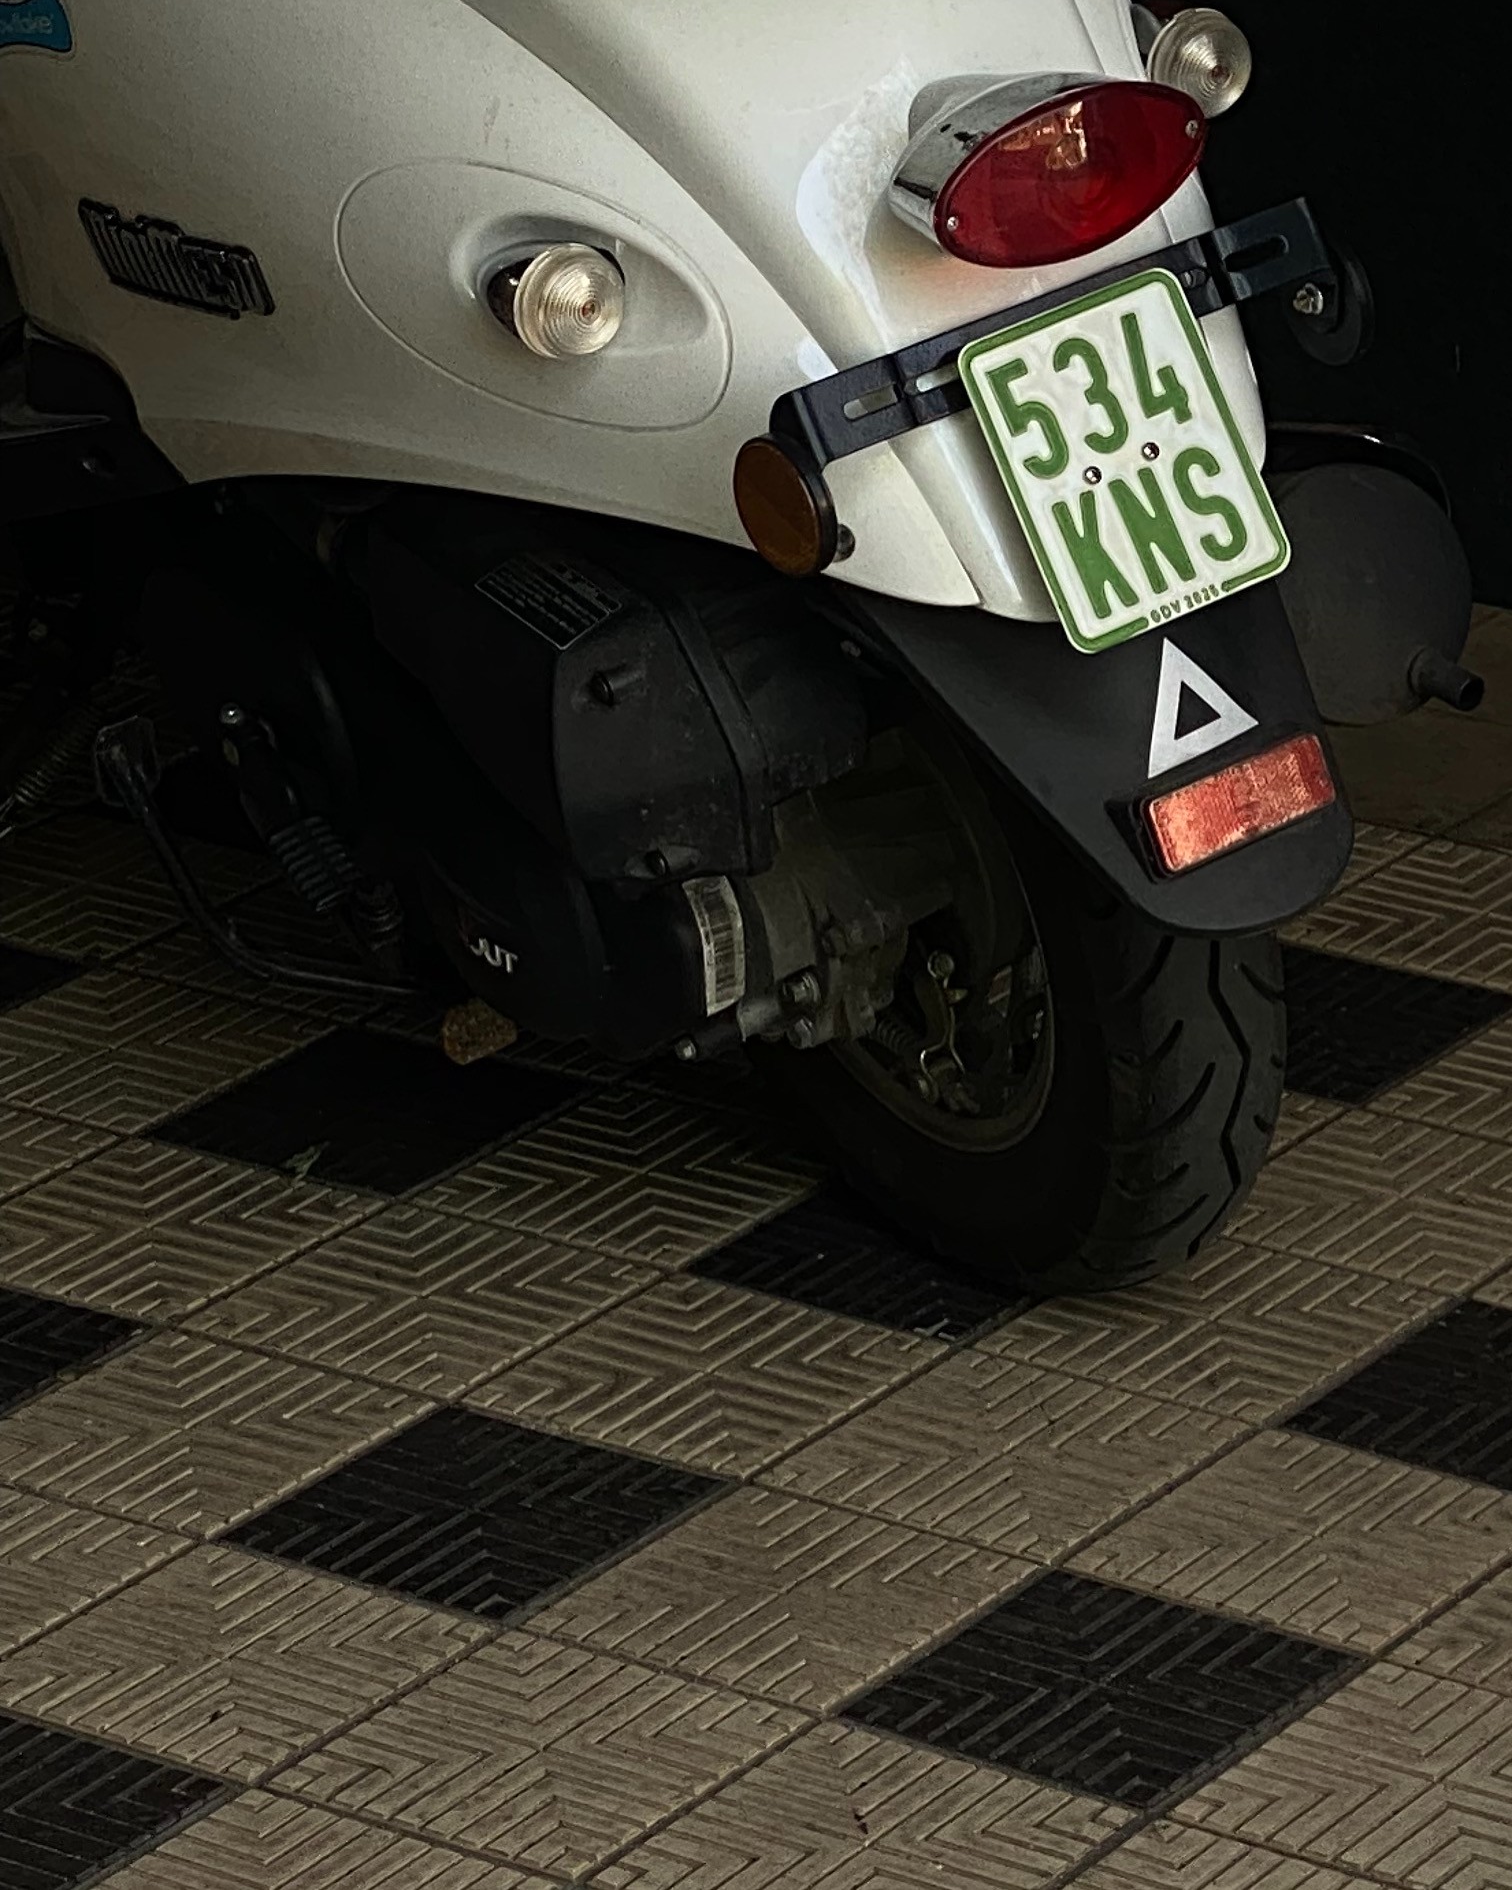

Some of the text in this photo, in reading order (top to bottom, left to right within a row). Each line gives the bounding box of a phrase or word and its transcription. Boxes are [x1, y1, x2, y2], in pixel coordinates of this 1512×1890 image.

[985, 312, 1193, 479] 534
[1051, 447, 1248, 619] KNS
[1150, 599, 1181, 623] GDV
